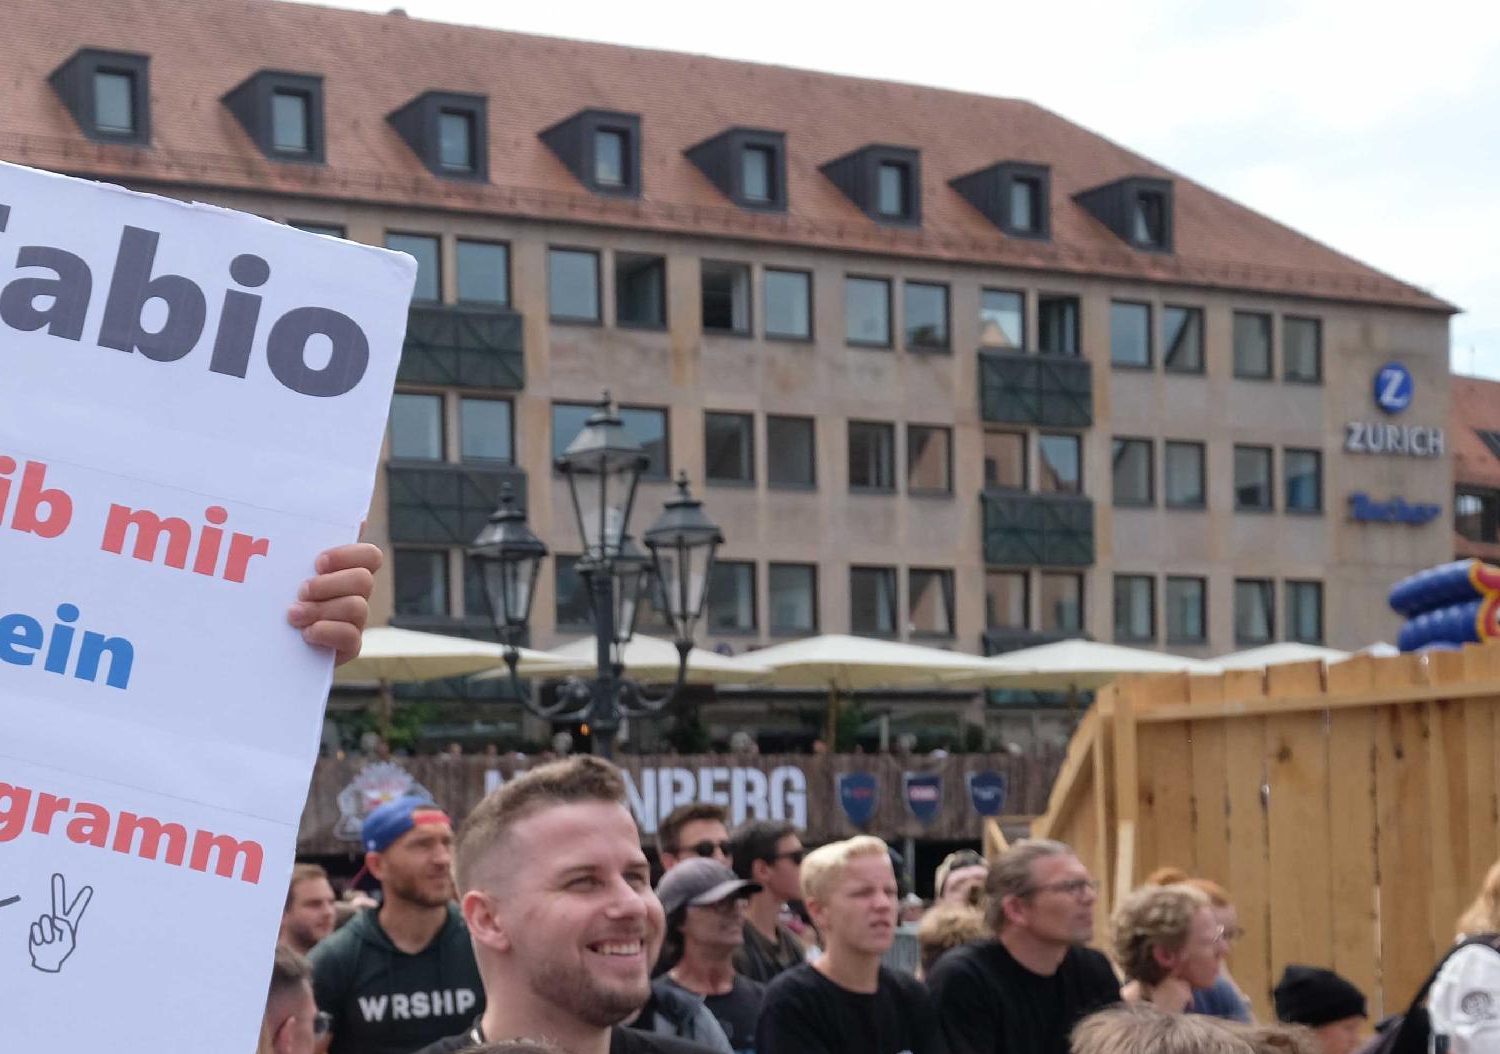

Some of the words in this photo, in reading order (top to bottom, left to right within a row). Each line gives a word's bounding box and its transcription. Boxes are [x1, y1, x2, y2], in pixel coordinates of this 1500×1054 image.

[1379, 368, 1408, 407] Z
[1347, 422, 1444, 455] ZURICH
[100, 503, 270, 584] mir
[358, 988, 476, 1022] WRSHP
